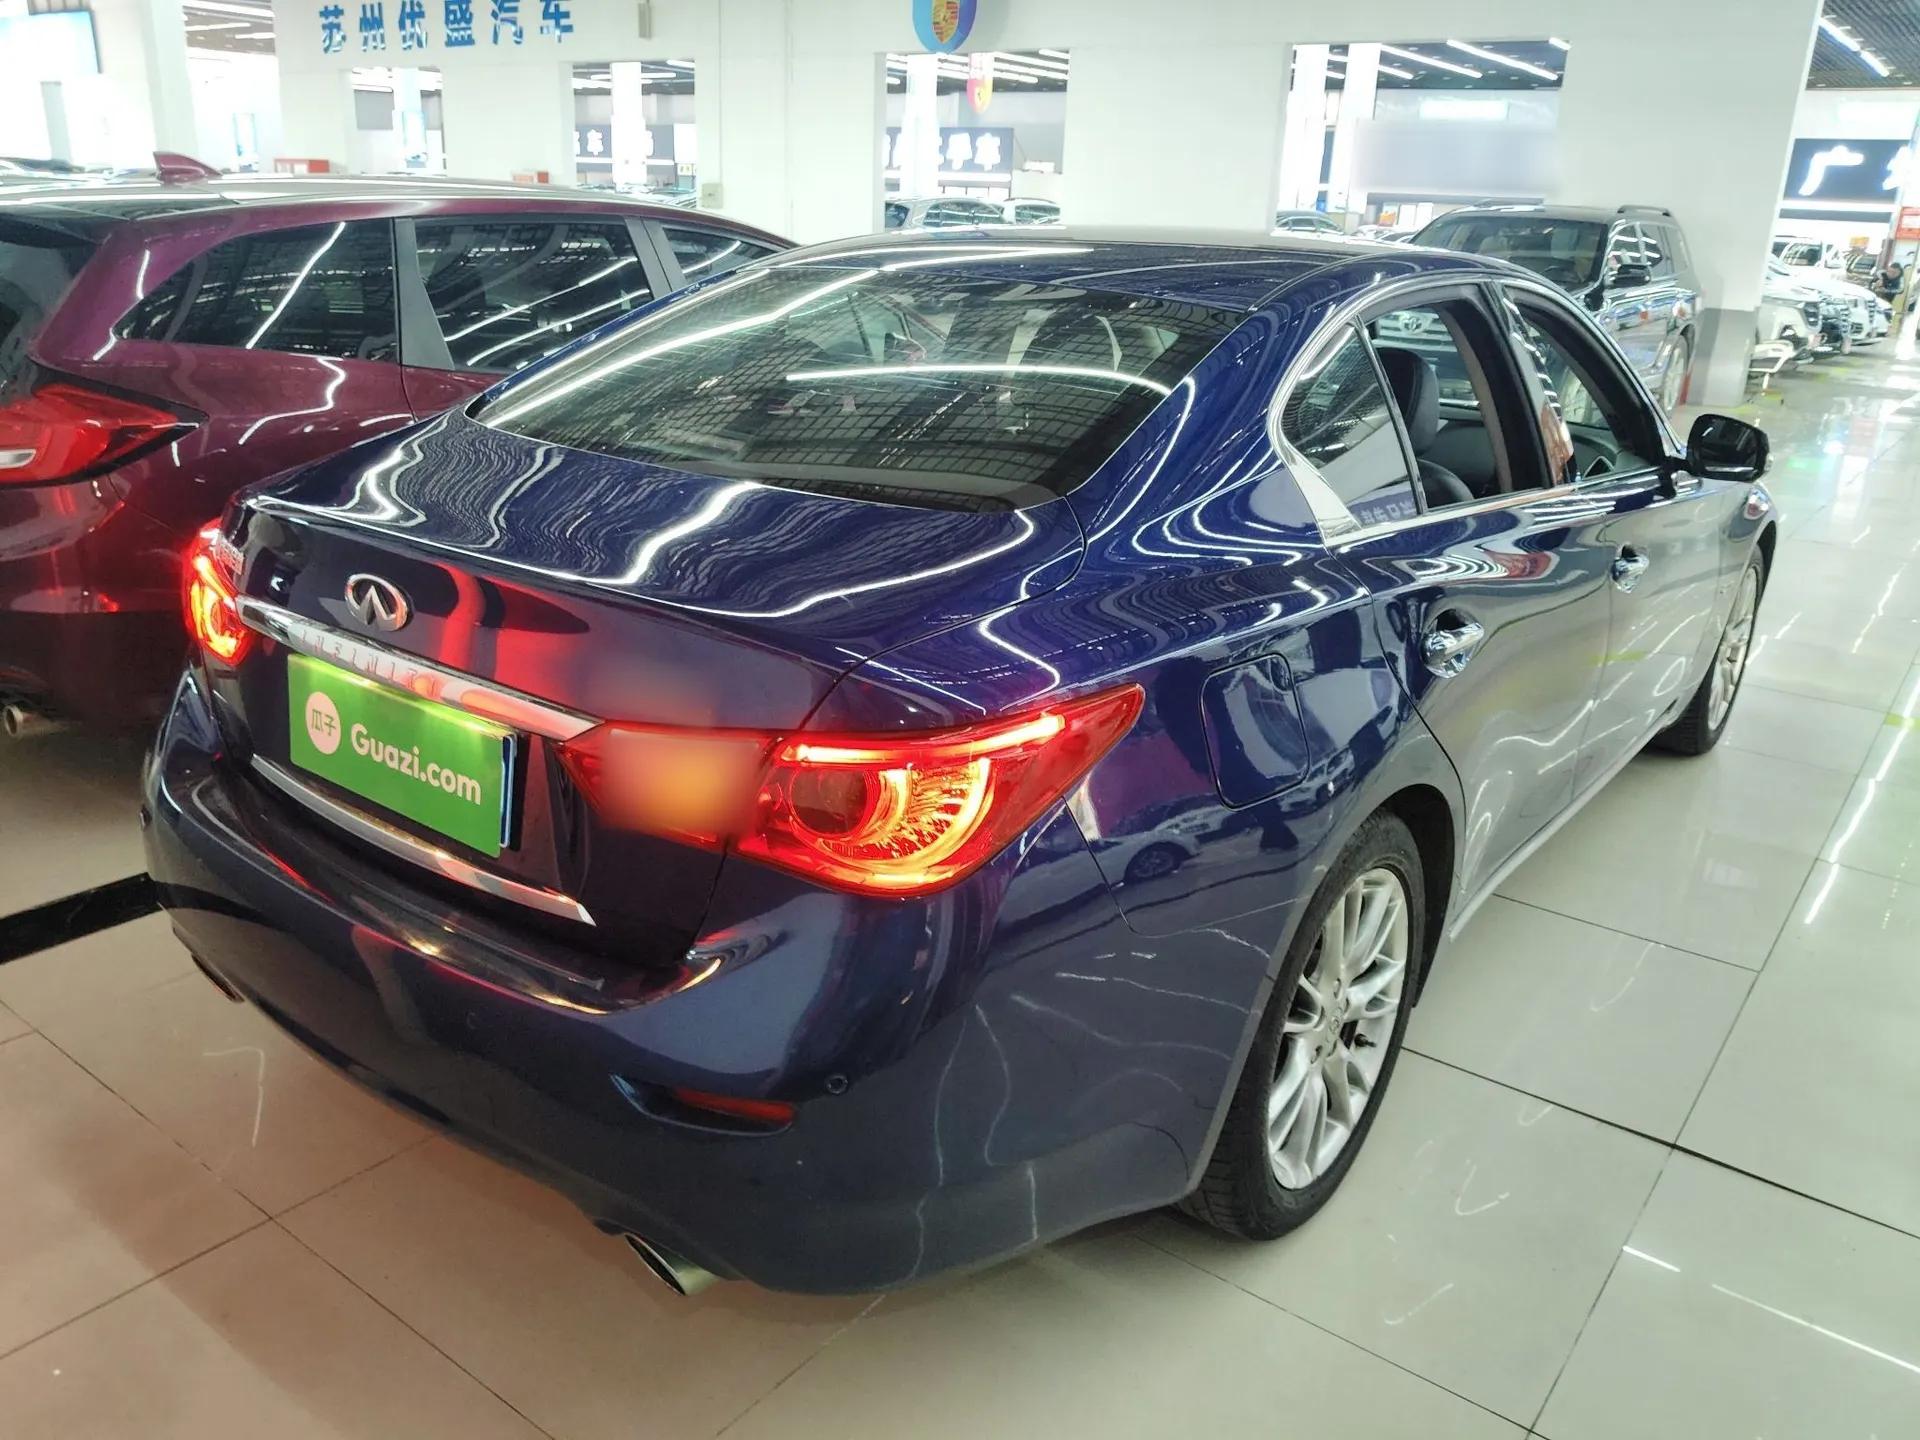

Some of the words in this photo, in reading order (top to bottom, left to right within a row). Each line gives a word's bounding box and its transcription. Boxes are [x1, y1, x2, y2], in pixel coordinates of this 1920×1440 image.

[319, 0, 574, 53] 苏州优盛汽车
[311, 708, 337, 737] 瓜子
[351, 722, 482, 806] Guazi.com
